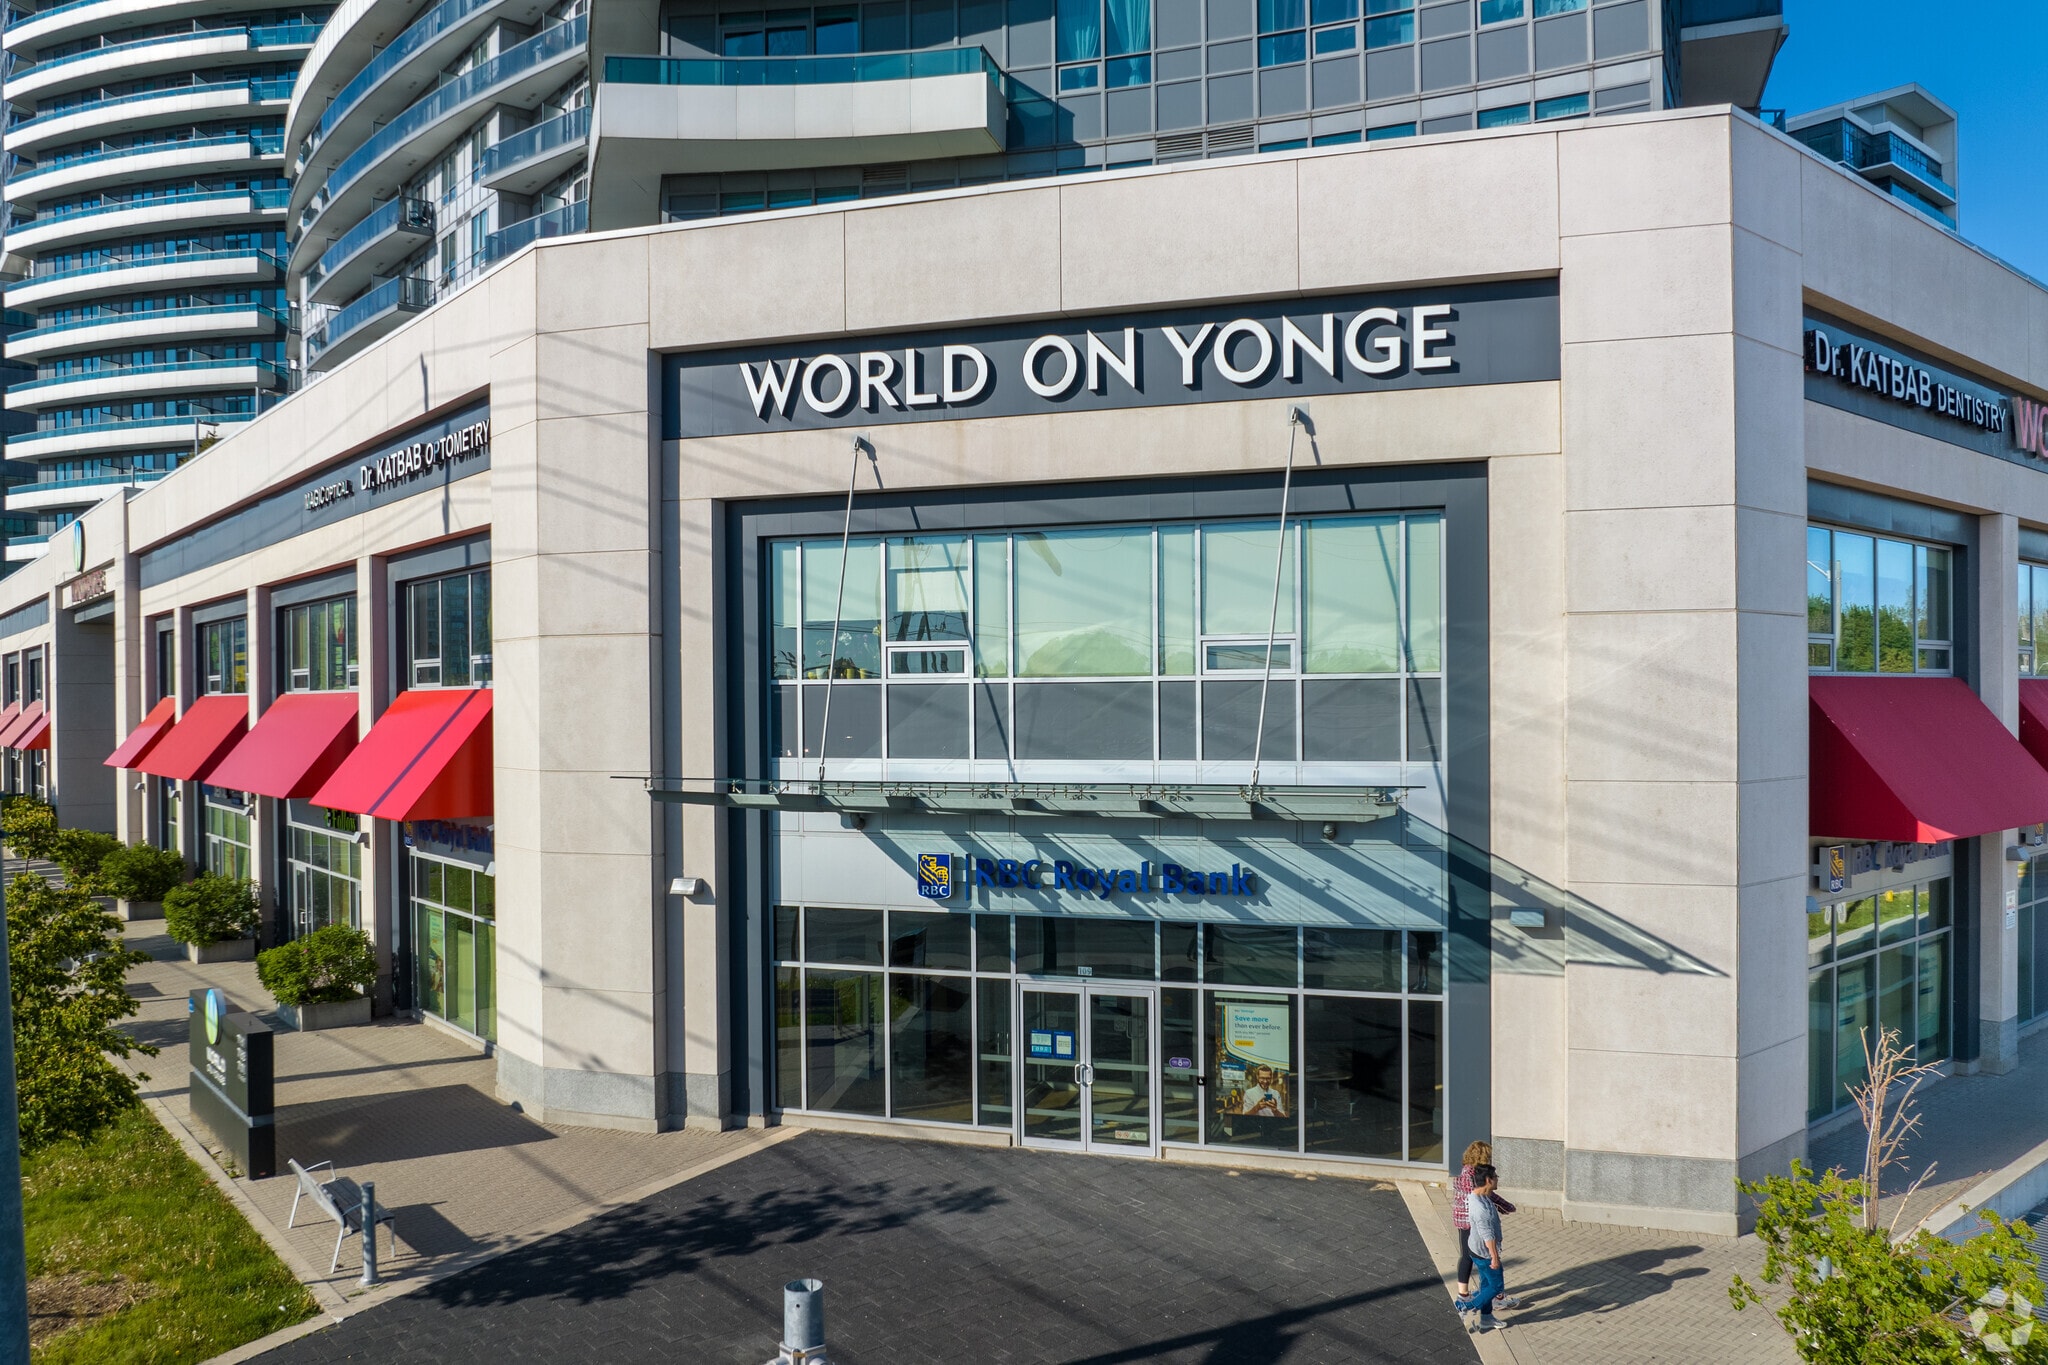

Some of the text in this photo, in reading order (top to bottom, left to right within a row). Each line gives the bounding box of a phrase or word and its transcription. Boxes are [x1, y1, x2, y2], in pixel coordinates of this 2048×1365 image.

[739, 304, 1453, 419] WORLD ON YONGE
[1815, 329, 2007, 433] Dr. KATBAB DENTISTRY
[360, 418, 490, 491] Dr. KATBAB OPTOMETRY
[325, 480, 350, 502] OPTICAL
[1852, 844, 1881, 875] RBC
[921, 884, 948, 896] RBC
[975, 858, 1254, 900] RBC Royal Bank
[1830, 878, 1844, 890] RBC
[1234, 1014, 1251, 1022] Save
[1262, 1023, 1282, 1031] before.
